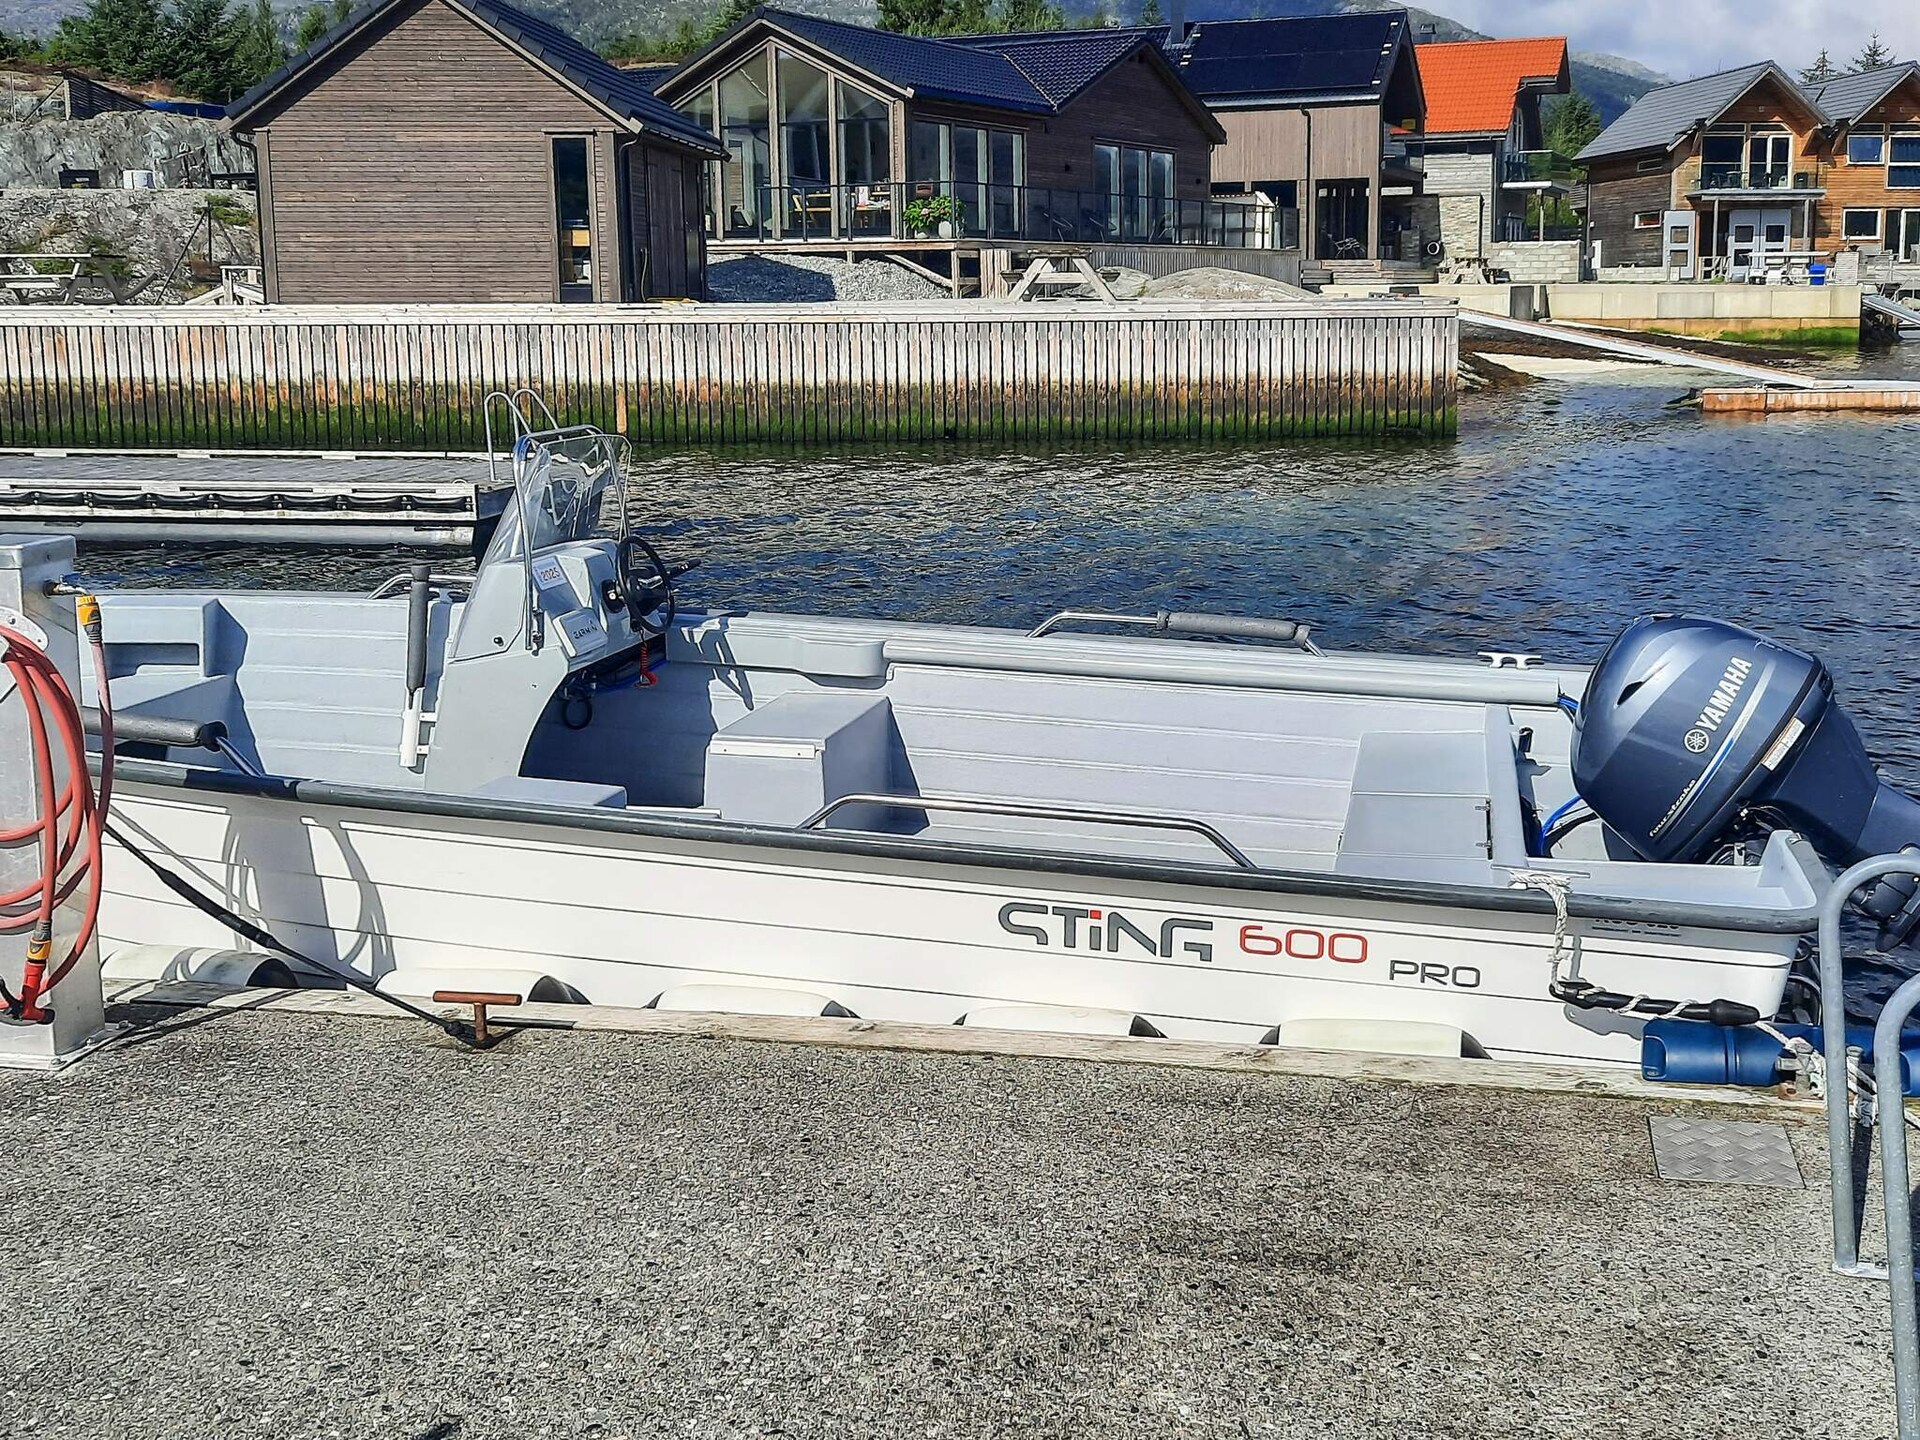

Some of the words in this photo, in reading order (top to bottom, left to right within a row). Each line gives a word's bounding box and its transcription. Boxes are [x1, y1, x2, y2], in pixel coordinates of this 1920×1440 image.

[1695, 657, 1752, 731] YAMAHA
[1239, 925, 1368, 964] 600
[1389, 960, 1480, 988] PRO
